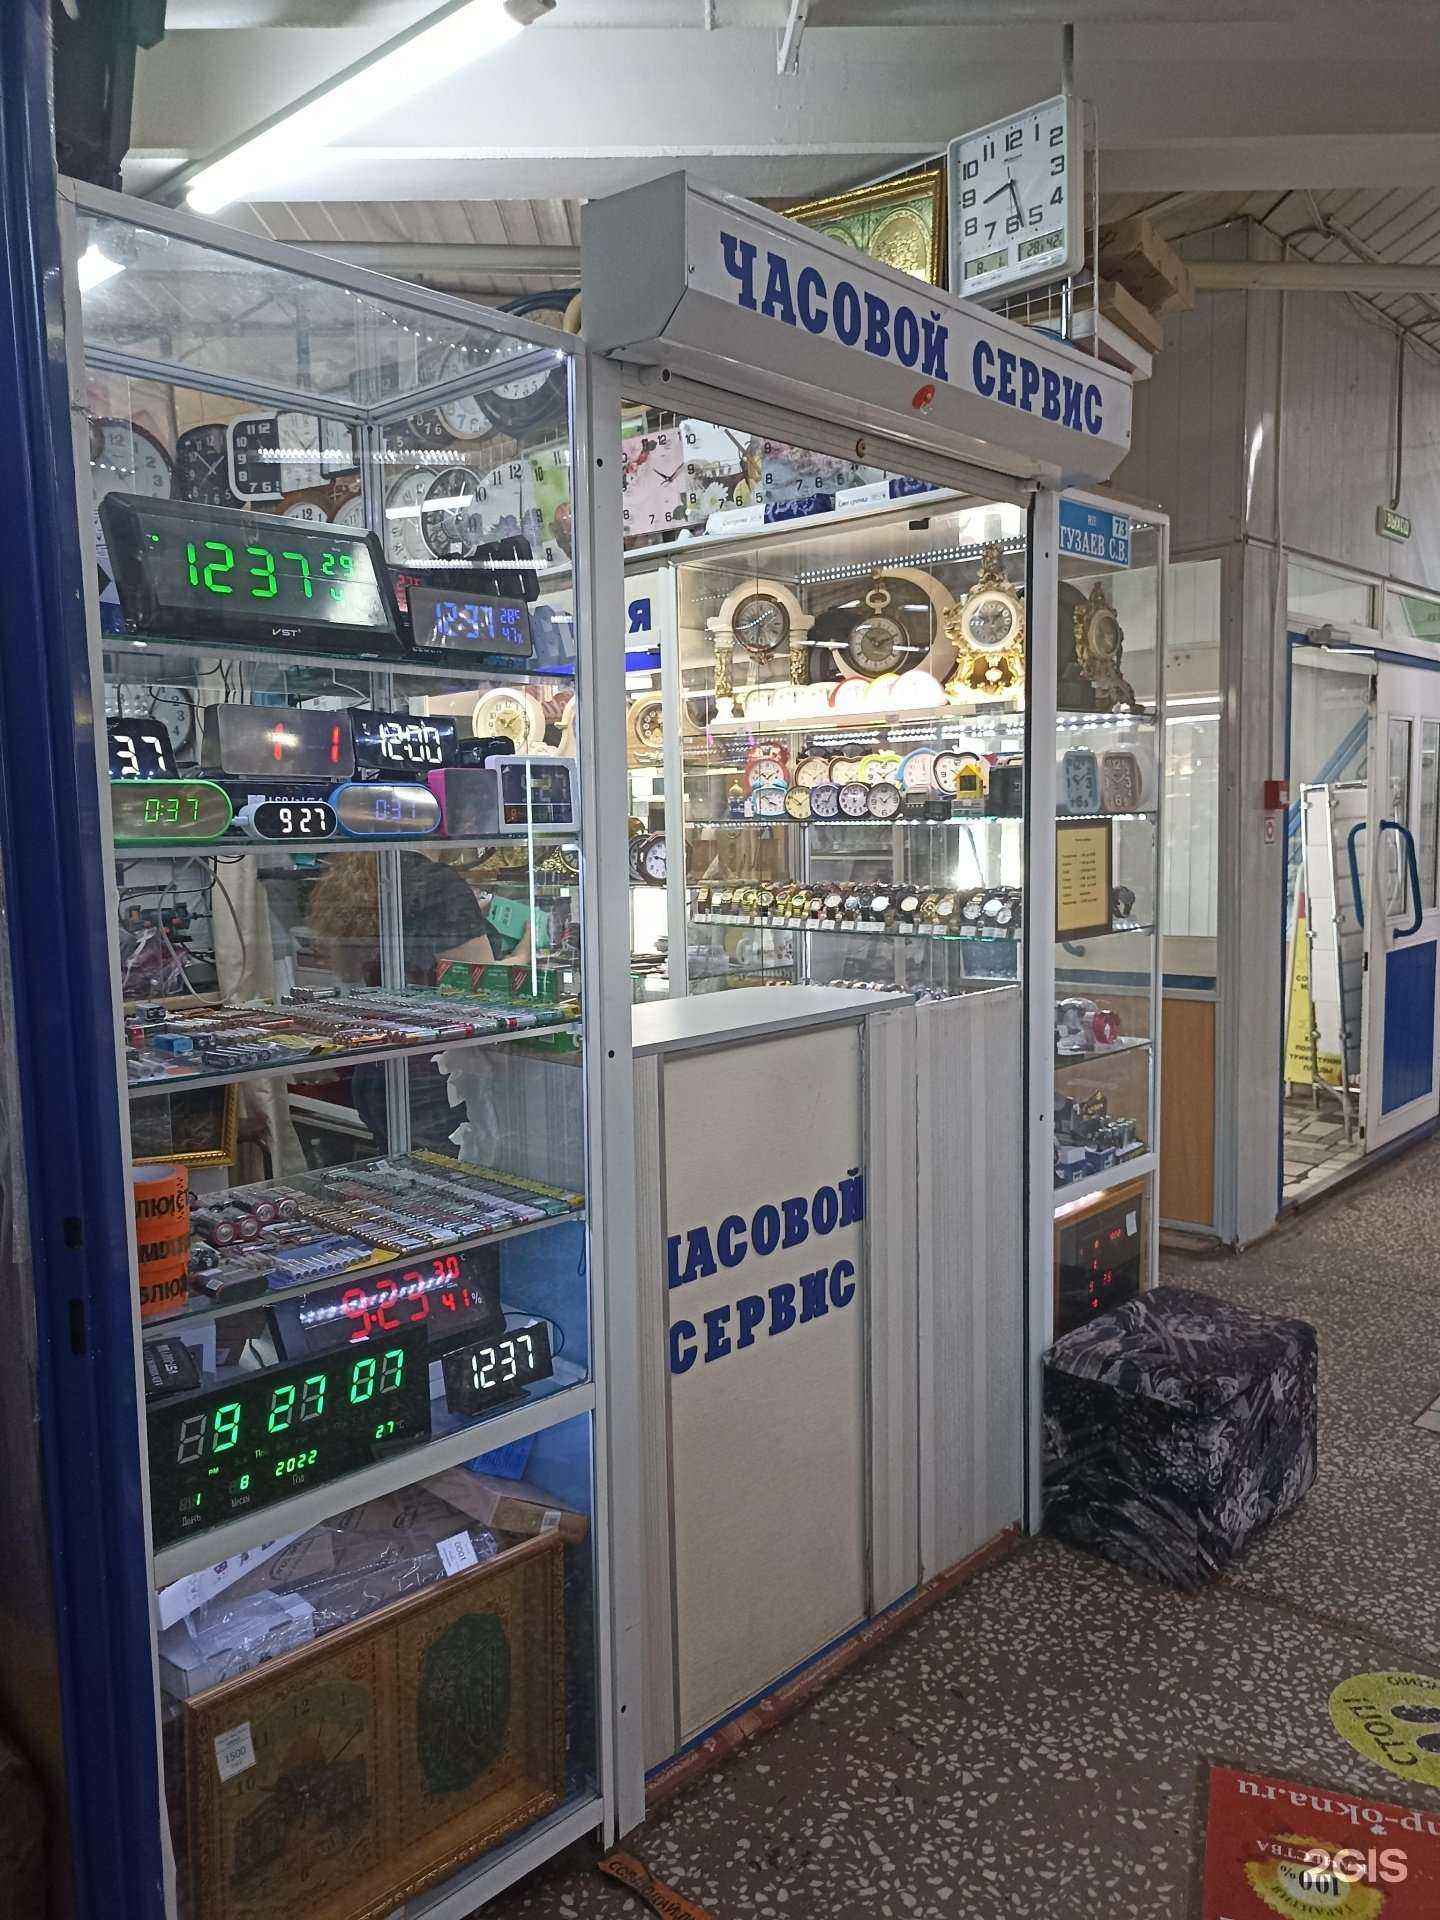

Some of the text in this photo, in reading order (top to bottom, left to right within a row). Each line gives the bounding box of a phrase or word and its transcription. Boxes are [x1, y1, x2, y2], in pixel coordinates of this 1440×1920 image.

[1005, 128, 1023, 152] 12
[1035, 122, 1040, 142] 1
[1049, 125, 1064, 148] 2
[983, 141, 995, 162] 11
[962, 160, 979, 181] 10
[1050, 155, 1065, 177] 3
[962, 189, 976, 208] 9
[1050, 186, 1064, 206] 4
[1029, 204, 1043, 226] 5
[965, 217, 978, 236] 8
[984, 221, 996, 241] 7
[1006, 215, 1021, 235] 6
[720, 231, 1104, 435] ЧАСОВОЙ СЕРВИС
[246, 425, 256, 435] 11
[258, 422, 271, 435] 12
[236, 436, 248, 448] 10
[658, 434, 667, 446] 12
[685, 433, 697, 445] 10
[764, 442, 772, 454] 9
[237, 454, 247, 465] 9
[238, 471, 248, 482] 8
[509, 463, 522, 480] 12
[687, 464, 695, 475] 9
[262, 481, 271, 492] 6
[492, 471, 502, 486] 11
[765, 473, 773, 485] 8
[796, 479, 803, 492] 7
[815, 477, 823, 489] 6
[248, 482, 258, 493] 7
[475, 486, 487, 503] 10
[689, 493, 697, 504] 8
[719, 498, 725, 510] 7
[735, 496, 743, 507] 6
[756, 493, 763, 504] 5
[649, 514, 655, 525] 7
[665, 512, 672, 522] 6
[1060, 525, 1128, 563] ГУЗАЕВ С.В.
[272, 628, 298, 637] VST
[113, 735, 167, 775] 37
[144, 798, 200, 823] 0:37
[669, 1259, 856, 1375] СЕРВИС
[268, 1374, 326, 1433] 27
[275, 1449, 318, 1477] 2022
[239, 1474, 250, 1490] 8
[224, 1745, 247, 1764] 1500
